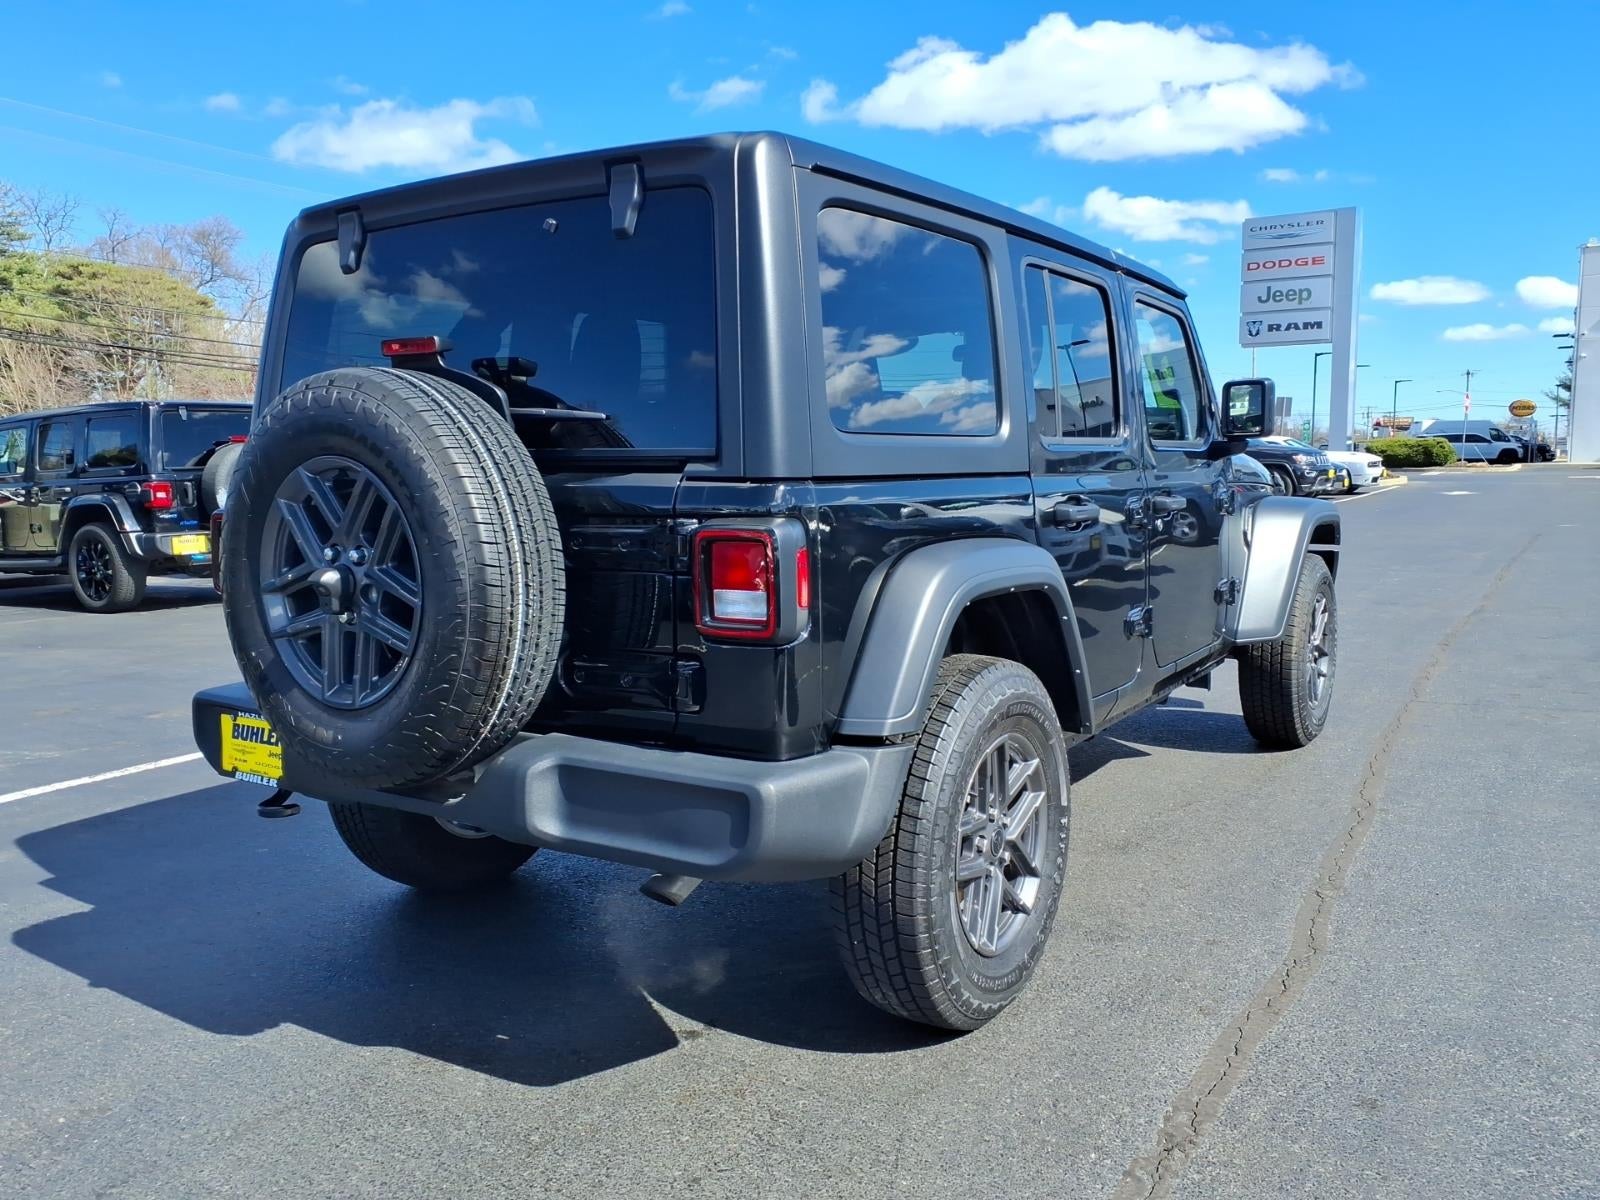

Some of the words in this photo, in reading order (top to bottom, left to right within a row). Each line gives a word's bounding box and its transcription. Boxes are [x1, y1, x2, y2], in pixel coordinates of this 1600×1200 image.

[1249, 219, 1325, 233] CHRYSLER
[1246, 256, 1326, 271] DODGE
[1257, 286, 1312, 304] Jeep
[1267, 321, 1323, 332] RAM
[232, 722, 281, 747] BUHLE
[235, 771, 278, 787] BUHLER
